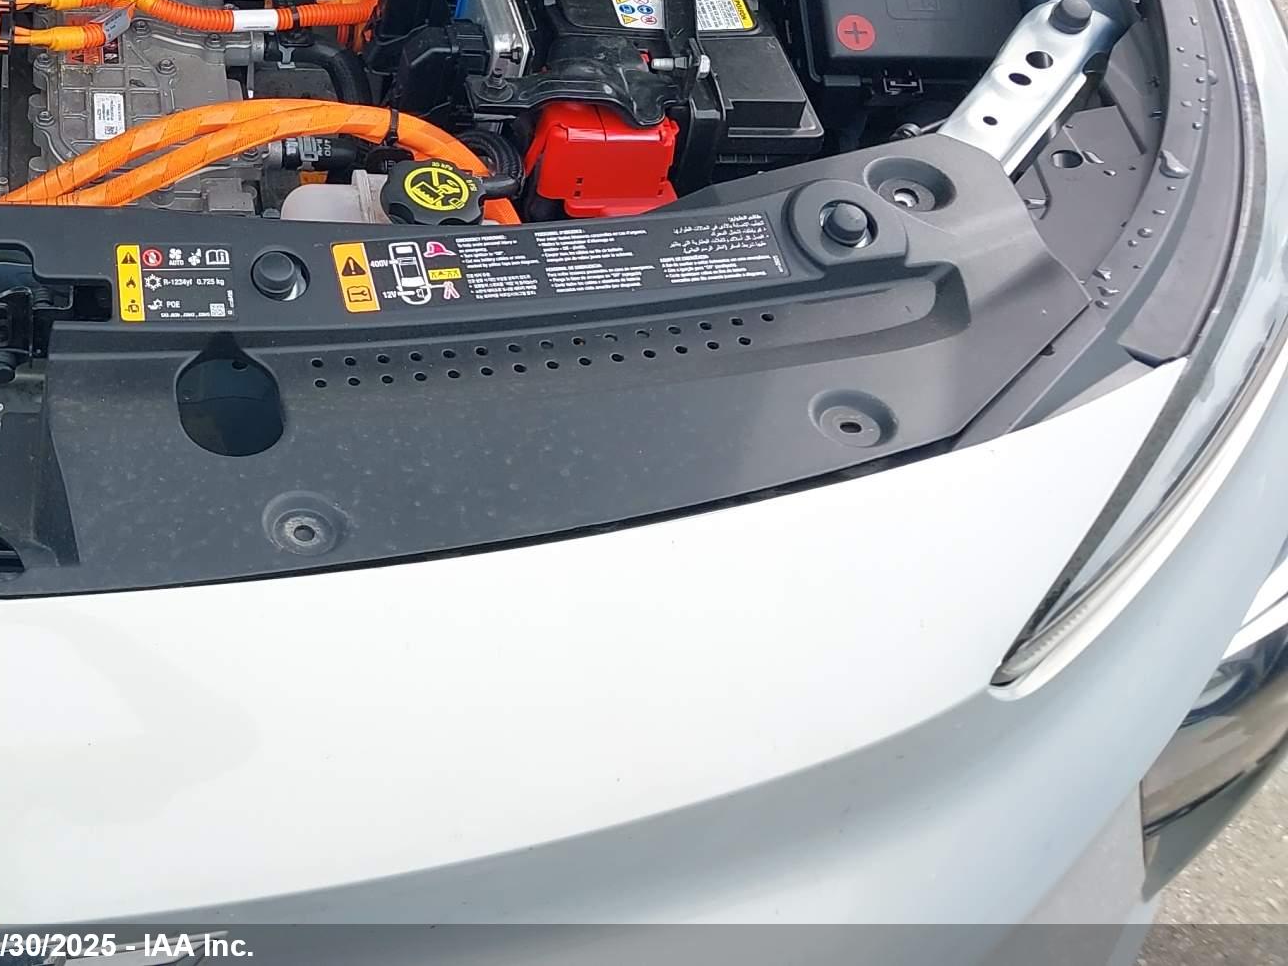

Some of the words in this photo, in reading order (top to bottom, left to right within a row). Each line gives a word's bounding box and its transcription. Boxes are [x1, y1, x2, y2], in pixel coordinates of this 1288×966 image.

[163, 278, 193, 287] R-1234yf
[216, 278, 225, 286] kg
[382, 290, 397, 299] 12V
